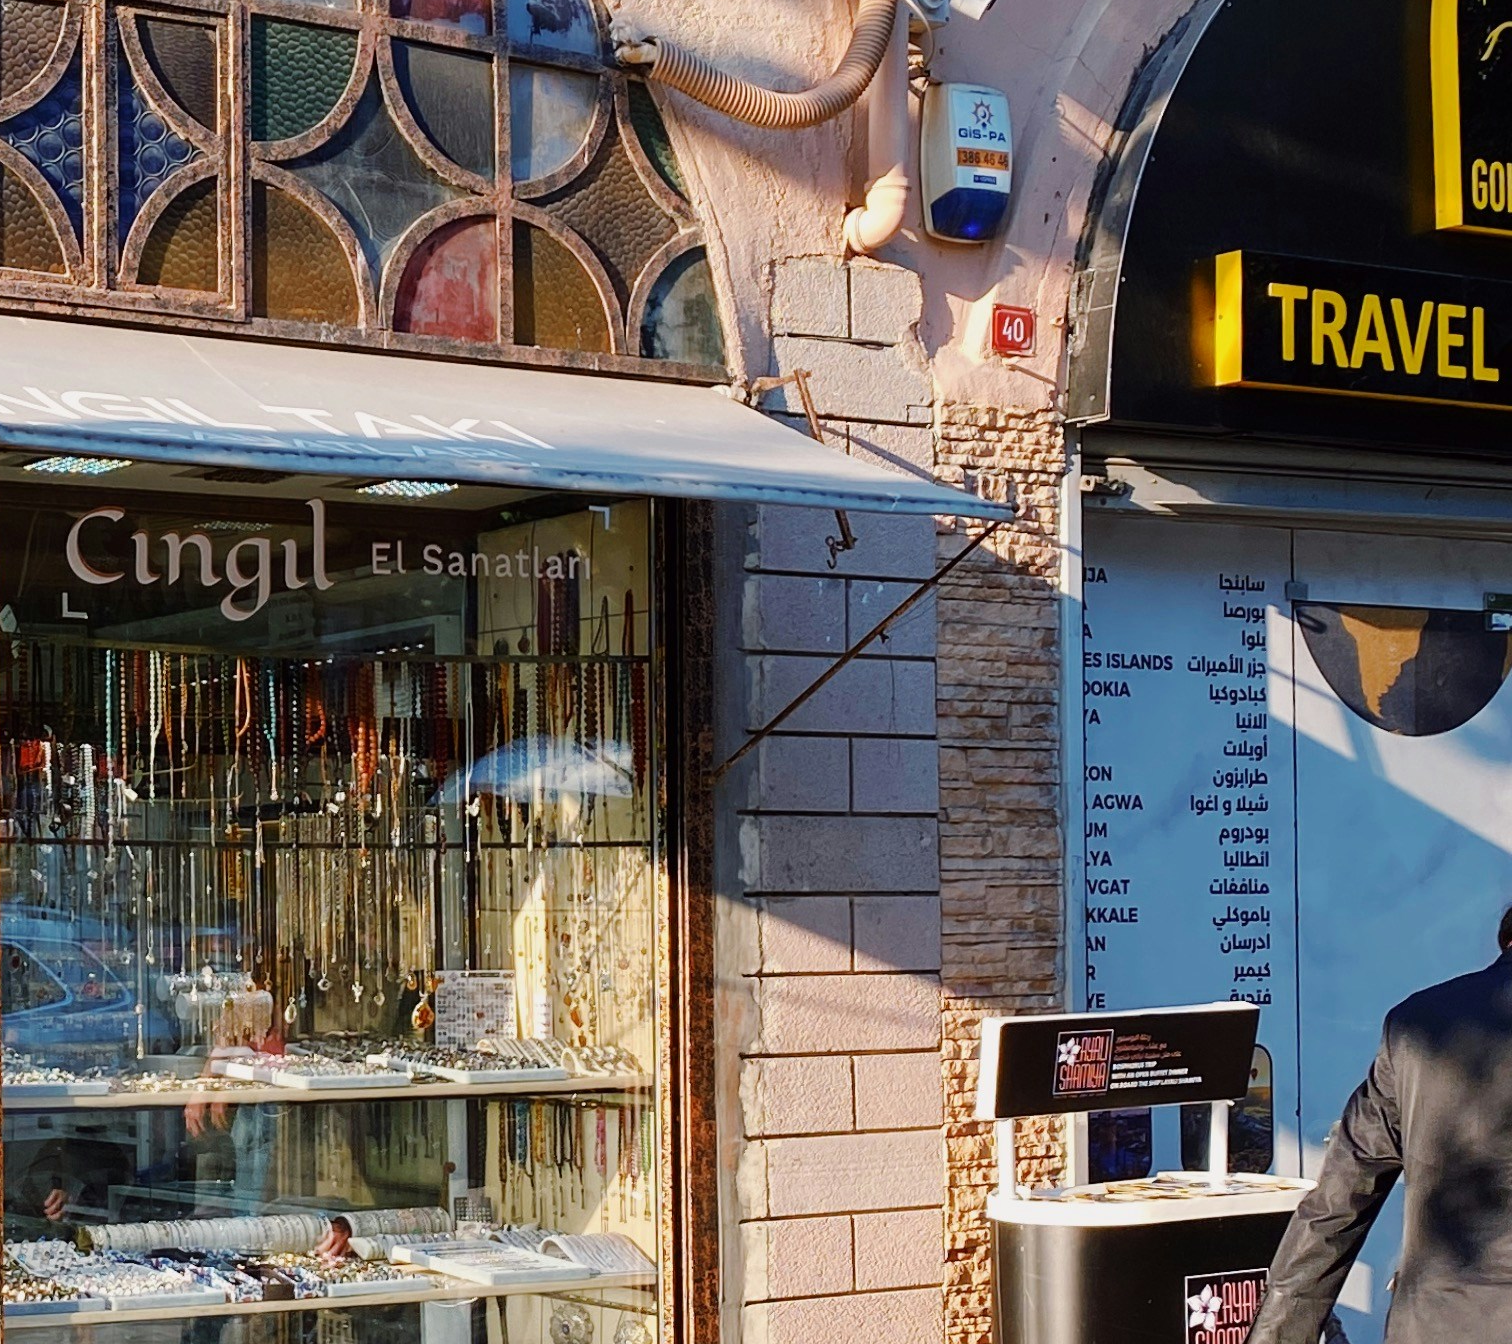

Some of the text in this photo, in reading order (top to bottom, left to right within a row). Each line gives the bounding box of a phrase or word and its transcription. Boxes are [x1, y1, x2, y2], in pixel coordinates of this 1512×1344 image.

[958, 126, 1006, 142] GİS-PA
[1002, 316, 1025, 342] 40
[1267, 281, 1500, 382] TRAVEL
[258, 405, 556, 449] TAKI
[67, 498, 591, 622] Cıngıl El Sanatları
[1219, 573, 1265, 595] سابنجا
[1223, 601, 1266, 624] بورصا
[1241, 630, 1266, 651] يلوا
[1106, 653, 1173, 671] ISLANDS
[1187, 654, 1266, 679] جزر الأميرات
[1209, 684, 1267, 706] كبادوكيا
[1236, 712, 1267, 733] الانيا
[1223, 735, 1267, 761] أويلات
[1084, 765, 1112, 782] ON
[1213, 767, 1268, 788] طرابزون
[1092, 794, 1143, 810] AGWA
[1190, 793, 1269, 816] شيلا و اغوا
[1219, 825, 1269, 846] بودروم
[1223, 850, 1270, 871] انطاليا
[1212, 906, 1270, 931] باموكلي
[1220, 933, 1270, 954] ادرسان
[1234, 962, 1271, 982] كيمير
[1059, 1062, 1107, 1090] SHAMIYA
